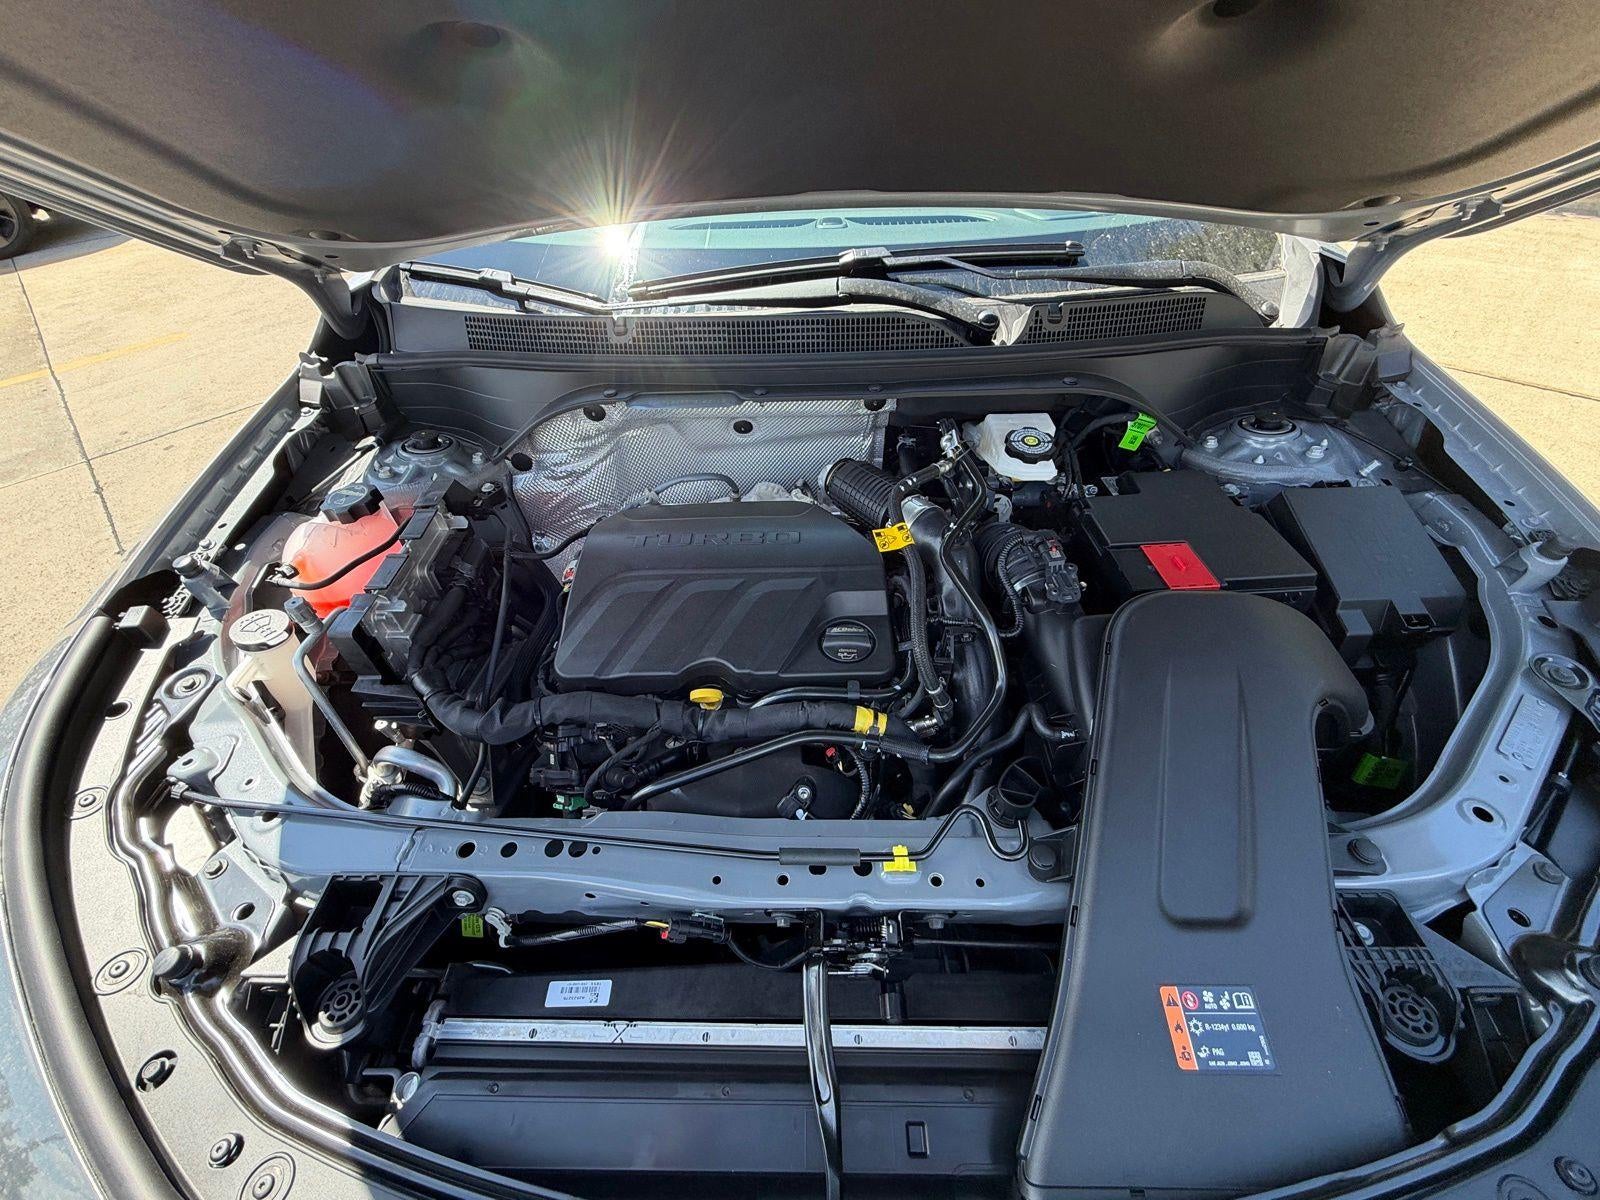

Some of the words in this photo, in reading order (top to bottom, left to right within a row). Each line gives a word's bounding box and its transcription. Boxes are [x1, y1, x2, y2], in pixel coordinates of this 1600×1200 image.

[627, 530, 801, 547] TURBO
[1205, 1024, 1229, 1032] R-1234yf
[1248, 1023, 1255, 1032] kg
[1212, 1048, 1224, 1056] PAG
